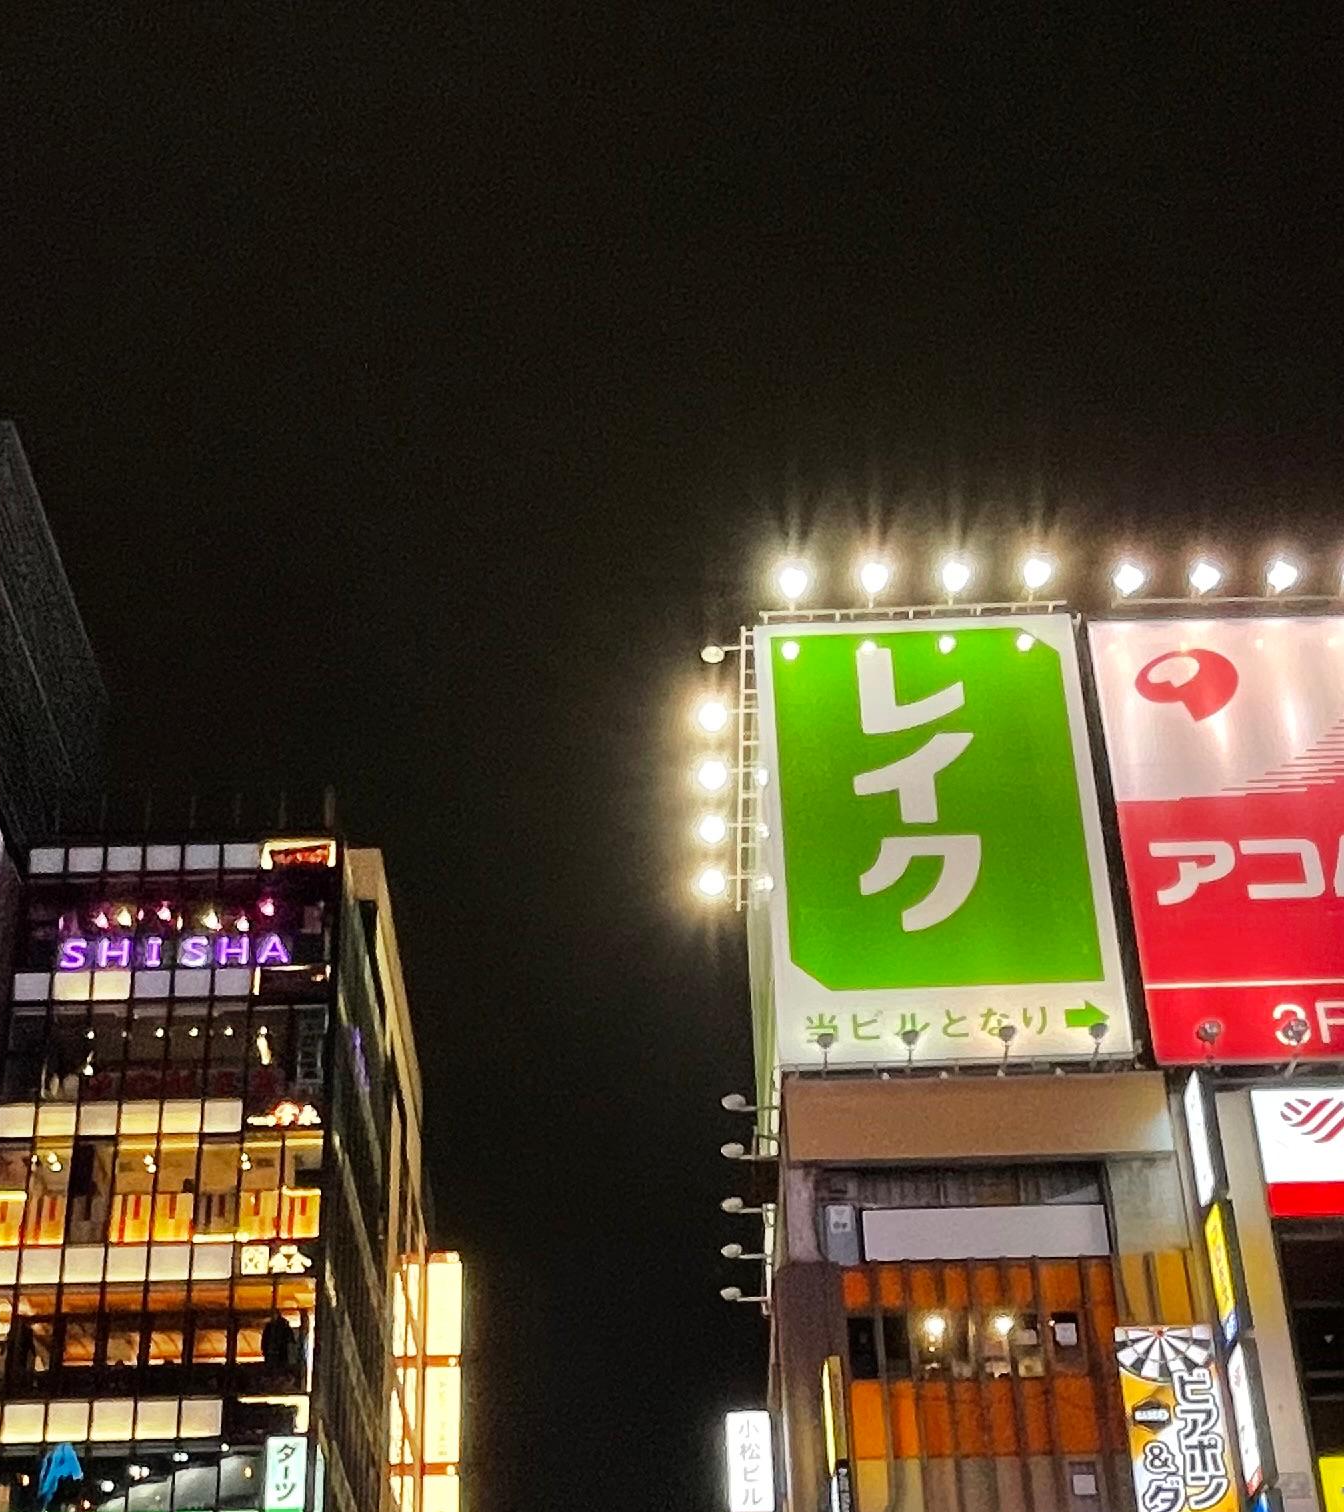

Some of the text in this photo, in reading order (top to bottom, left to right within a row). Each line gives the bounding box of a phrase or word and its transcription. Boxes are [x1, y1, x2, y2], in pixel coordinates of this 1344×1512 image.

[853, 647, 982, 932] レイク
[59, 935, 291, 968] SHISHA
[274, 1441, 297, 1501] ダーツ
[738, 1419, 763, 1506] 小松ビル
